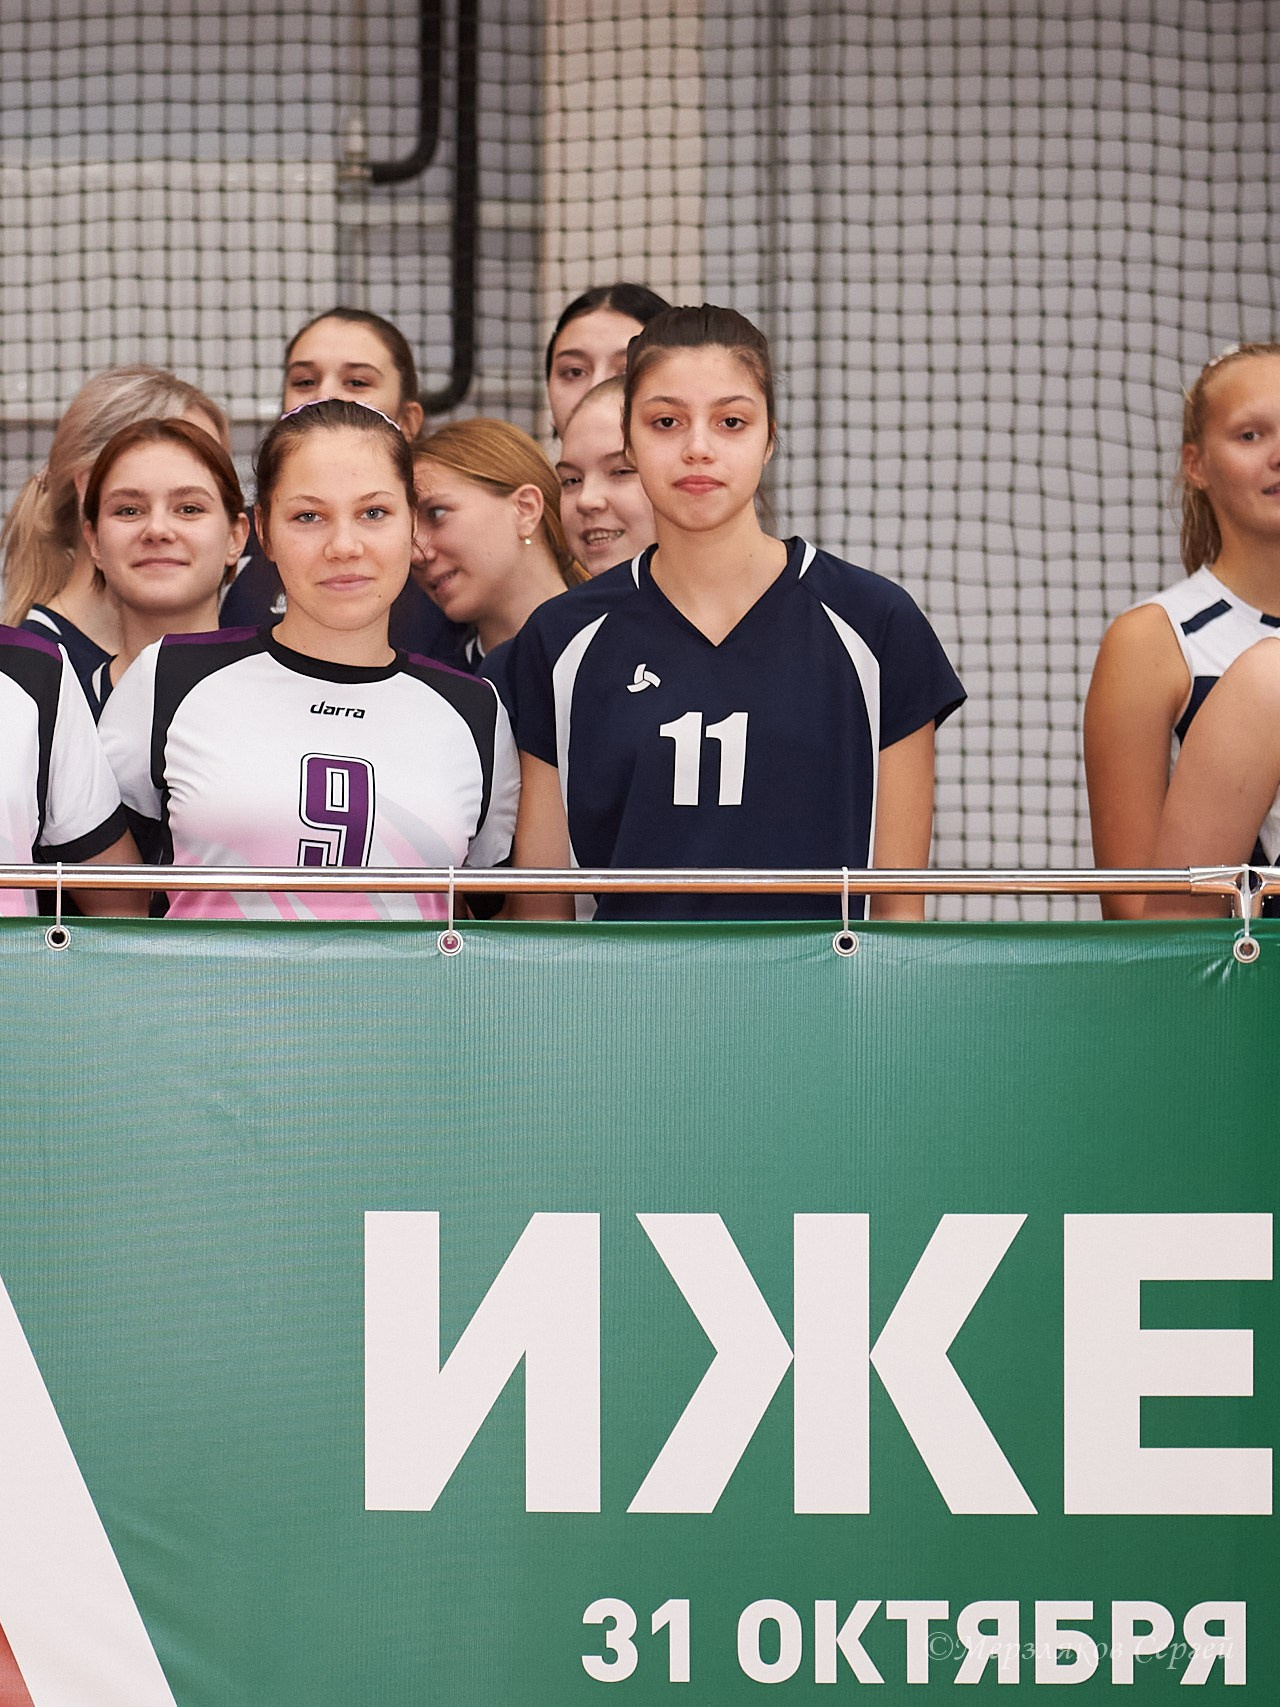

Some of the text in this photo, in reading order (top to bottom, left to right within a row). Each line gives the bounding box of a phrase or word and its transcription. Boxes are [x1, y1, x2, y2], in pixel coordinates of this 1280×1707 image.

[298, 752, 376, 867] 9
[659, 711, 749, 806] 11
[364, 1210, 1274, 1516] ИЖЕ
[581, 1598, 1247, 1686] 31 ОКТЯБРЯ
